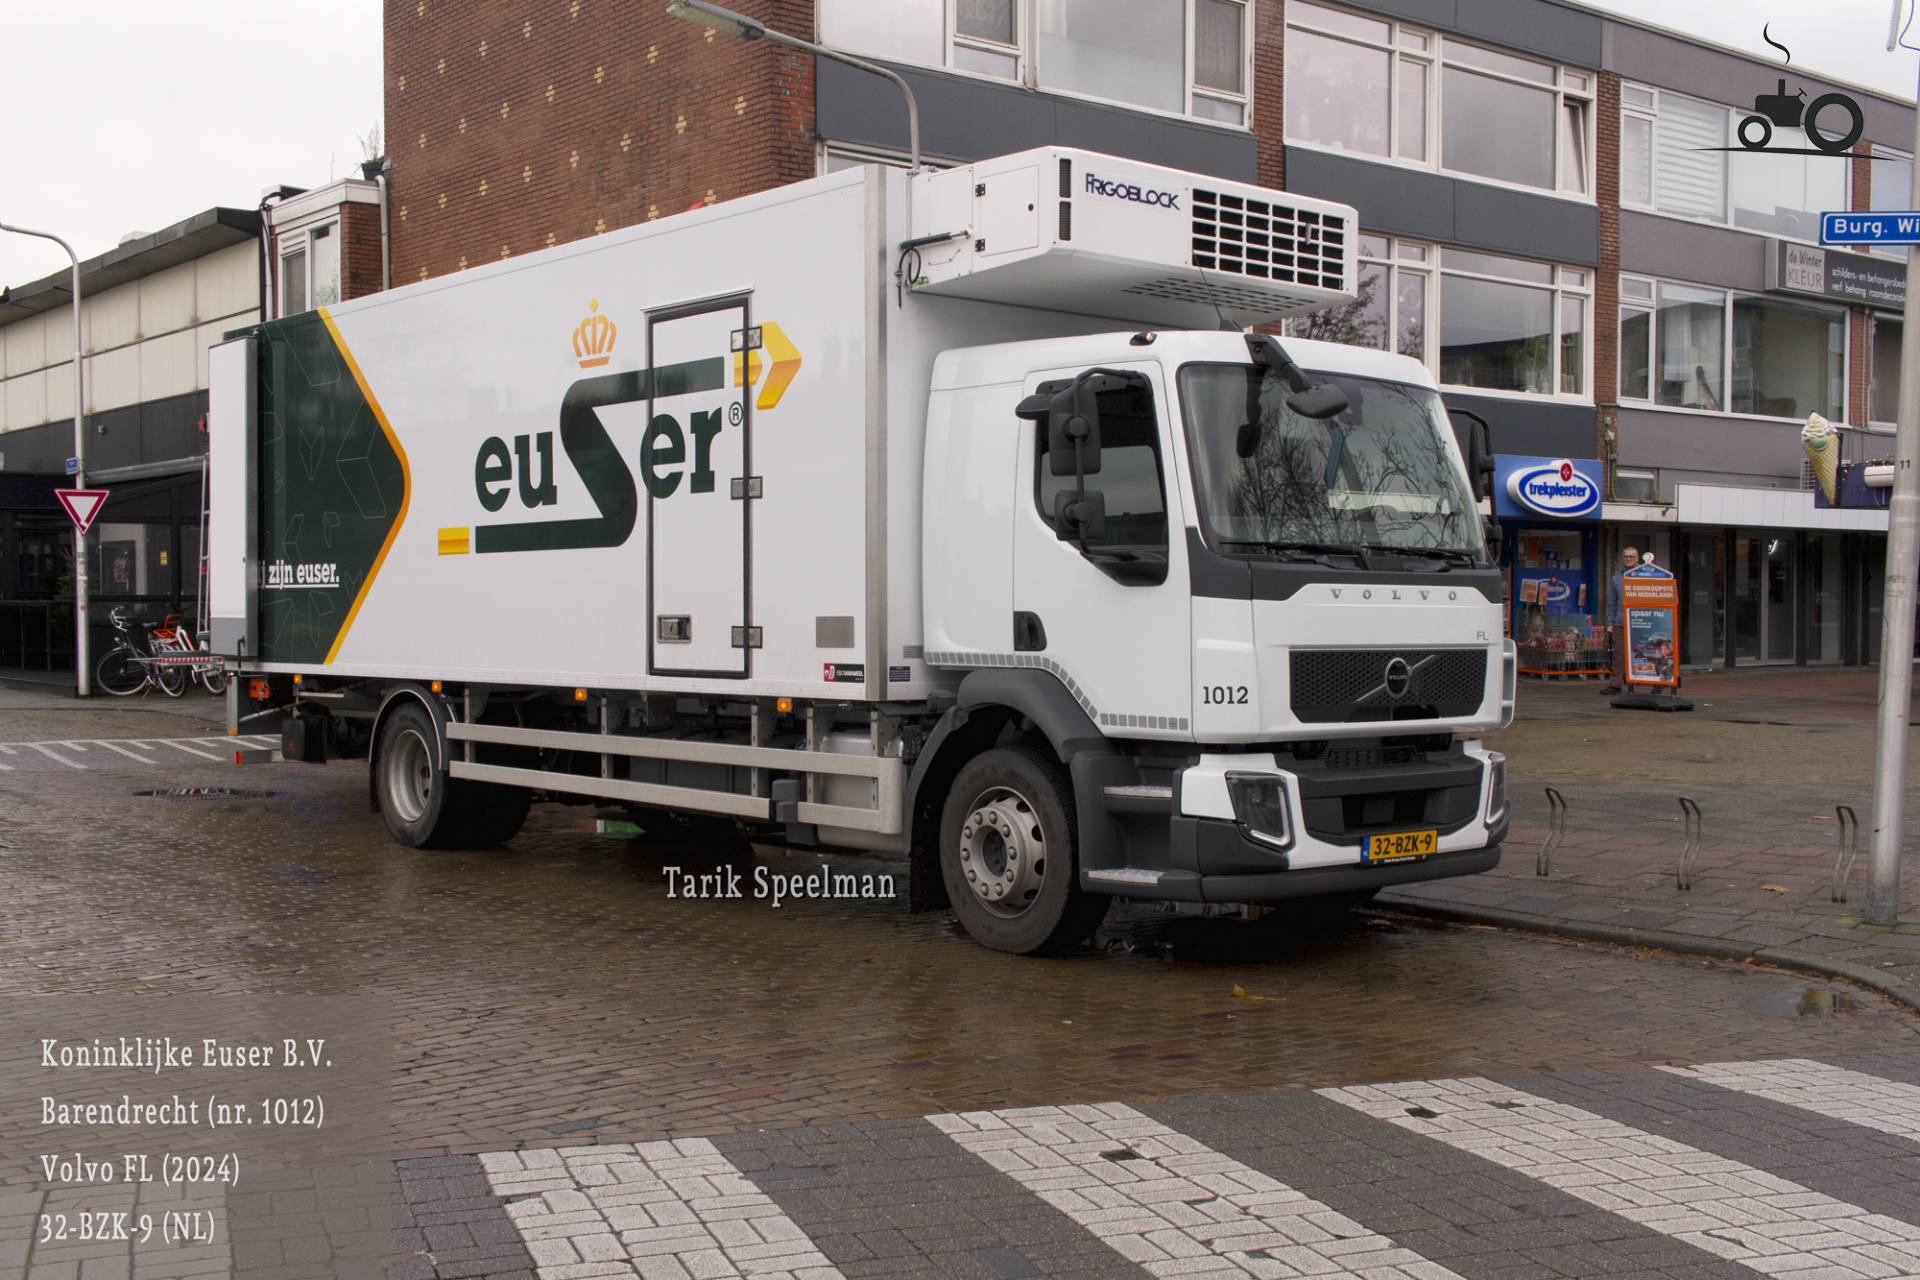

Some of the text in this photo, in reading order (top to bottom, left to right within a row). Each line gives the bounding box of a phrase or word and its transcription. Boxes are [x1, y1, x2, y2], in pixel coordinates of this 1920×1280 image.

[1085, 172, 1180, 211] FRIGOBLOCK
[1833, 218, 1888, 238] Burg.
[1788, 249, 1823, 268] de Winter
[1788, 267, 1823, 289] KLEUR
[1845, 282, 1867, 298] behang
[1528, 481, 1588, 499] trekpleister
[268, 559, 294, 590] zijn
[296, 562, 340, 584] euser.
[1330, 588, 1457, 601] VOLVO
[1630, 610, 1652, 618] spaar
[1476, 631, 1489, 641] FL
[1203, 686, 1249, 705] 1012
[1374, 833, 1433, 856] 32-BZK-9
